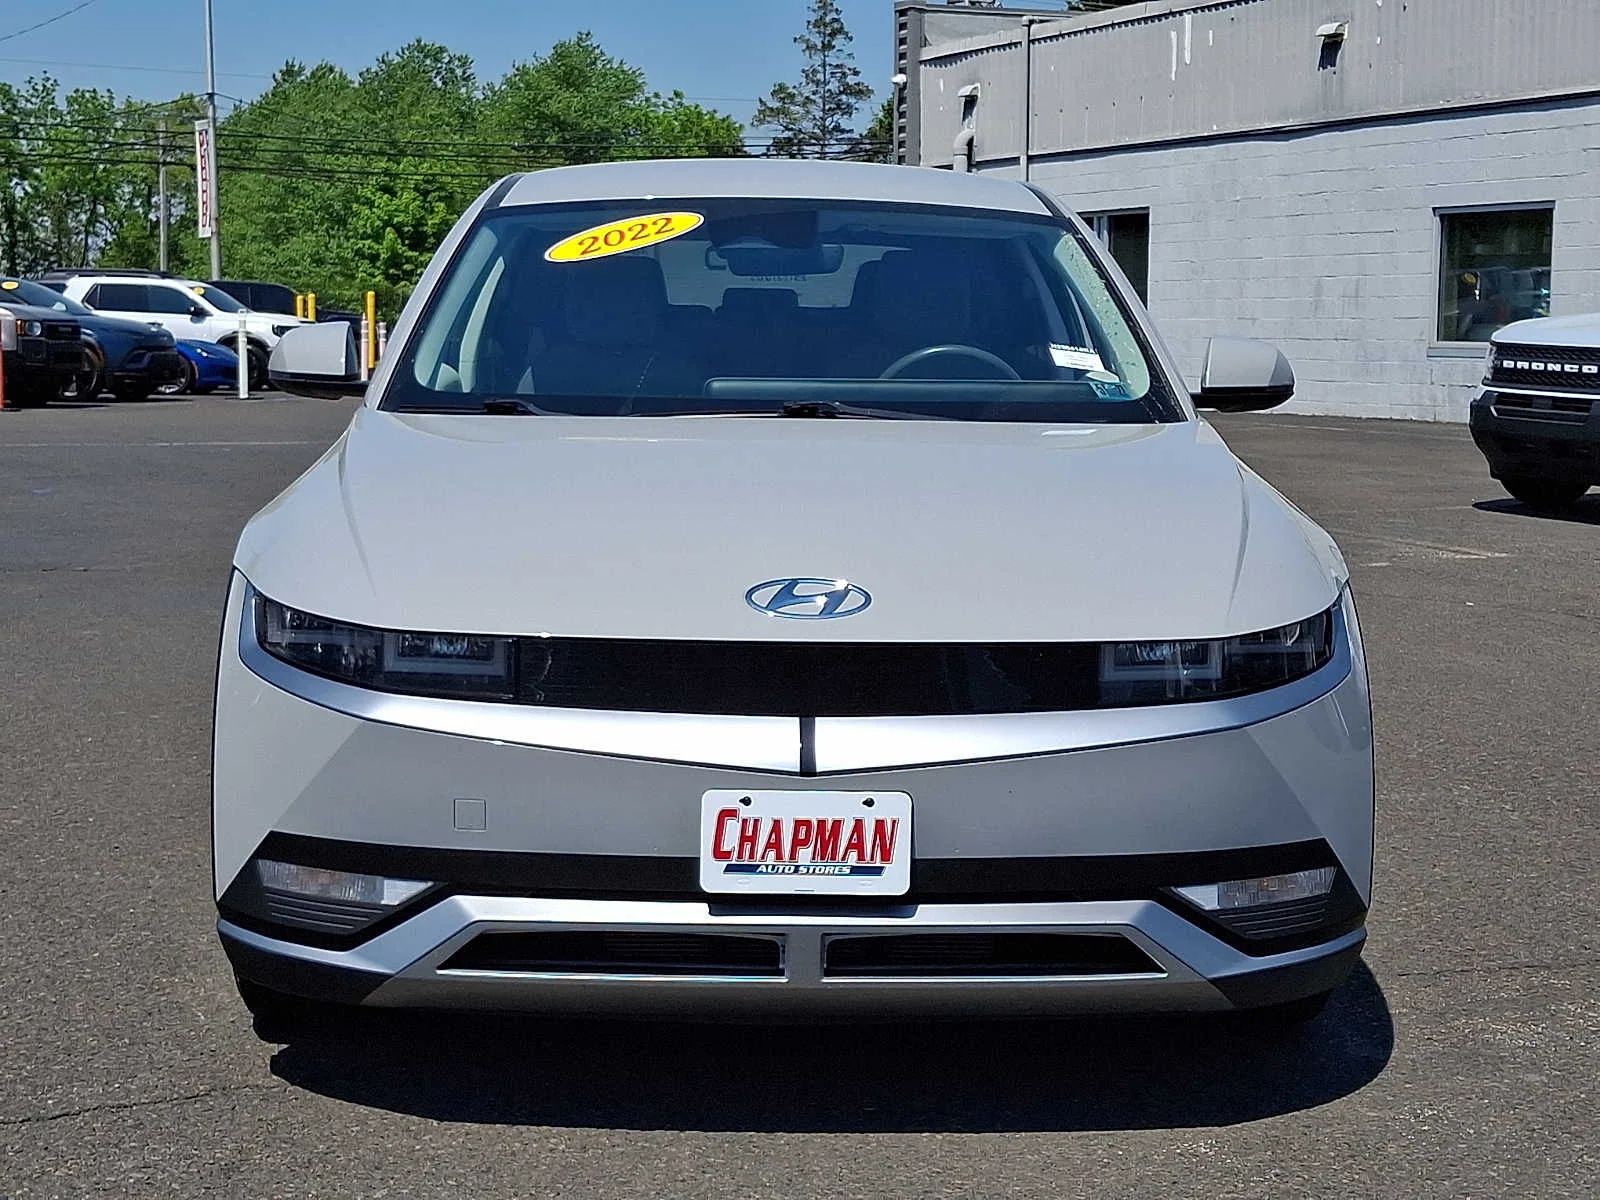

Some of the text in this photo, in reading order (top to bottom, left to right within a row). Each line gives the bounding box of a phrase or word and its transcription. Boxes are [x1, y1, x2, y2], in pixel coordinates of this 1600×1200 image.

[577, 217, 675, 256] 2022
[1502, 360, 1598, 374] BRONCO
[756, 865, 852, 875] AUTO STORES
